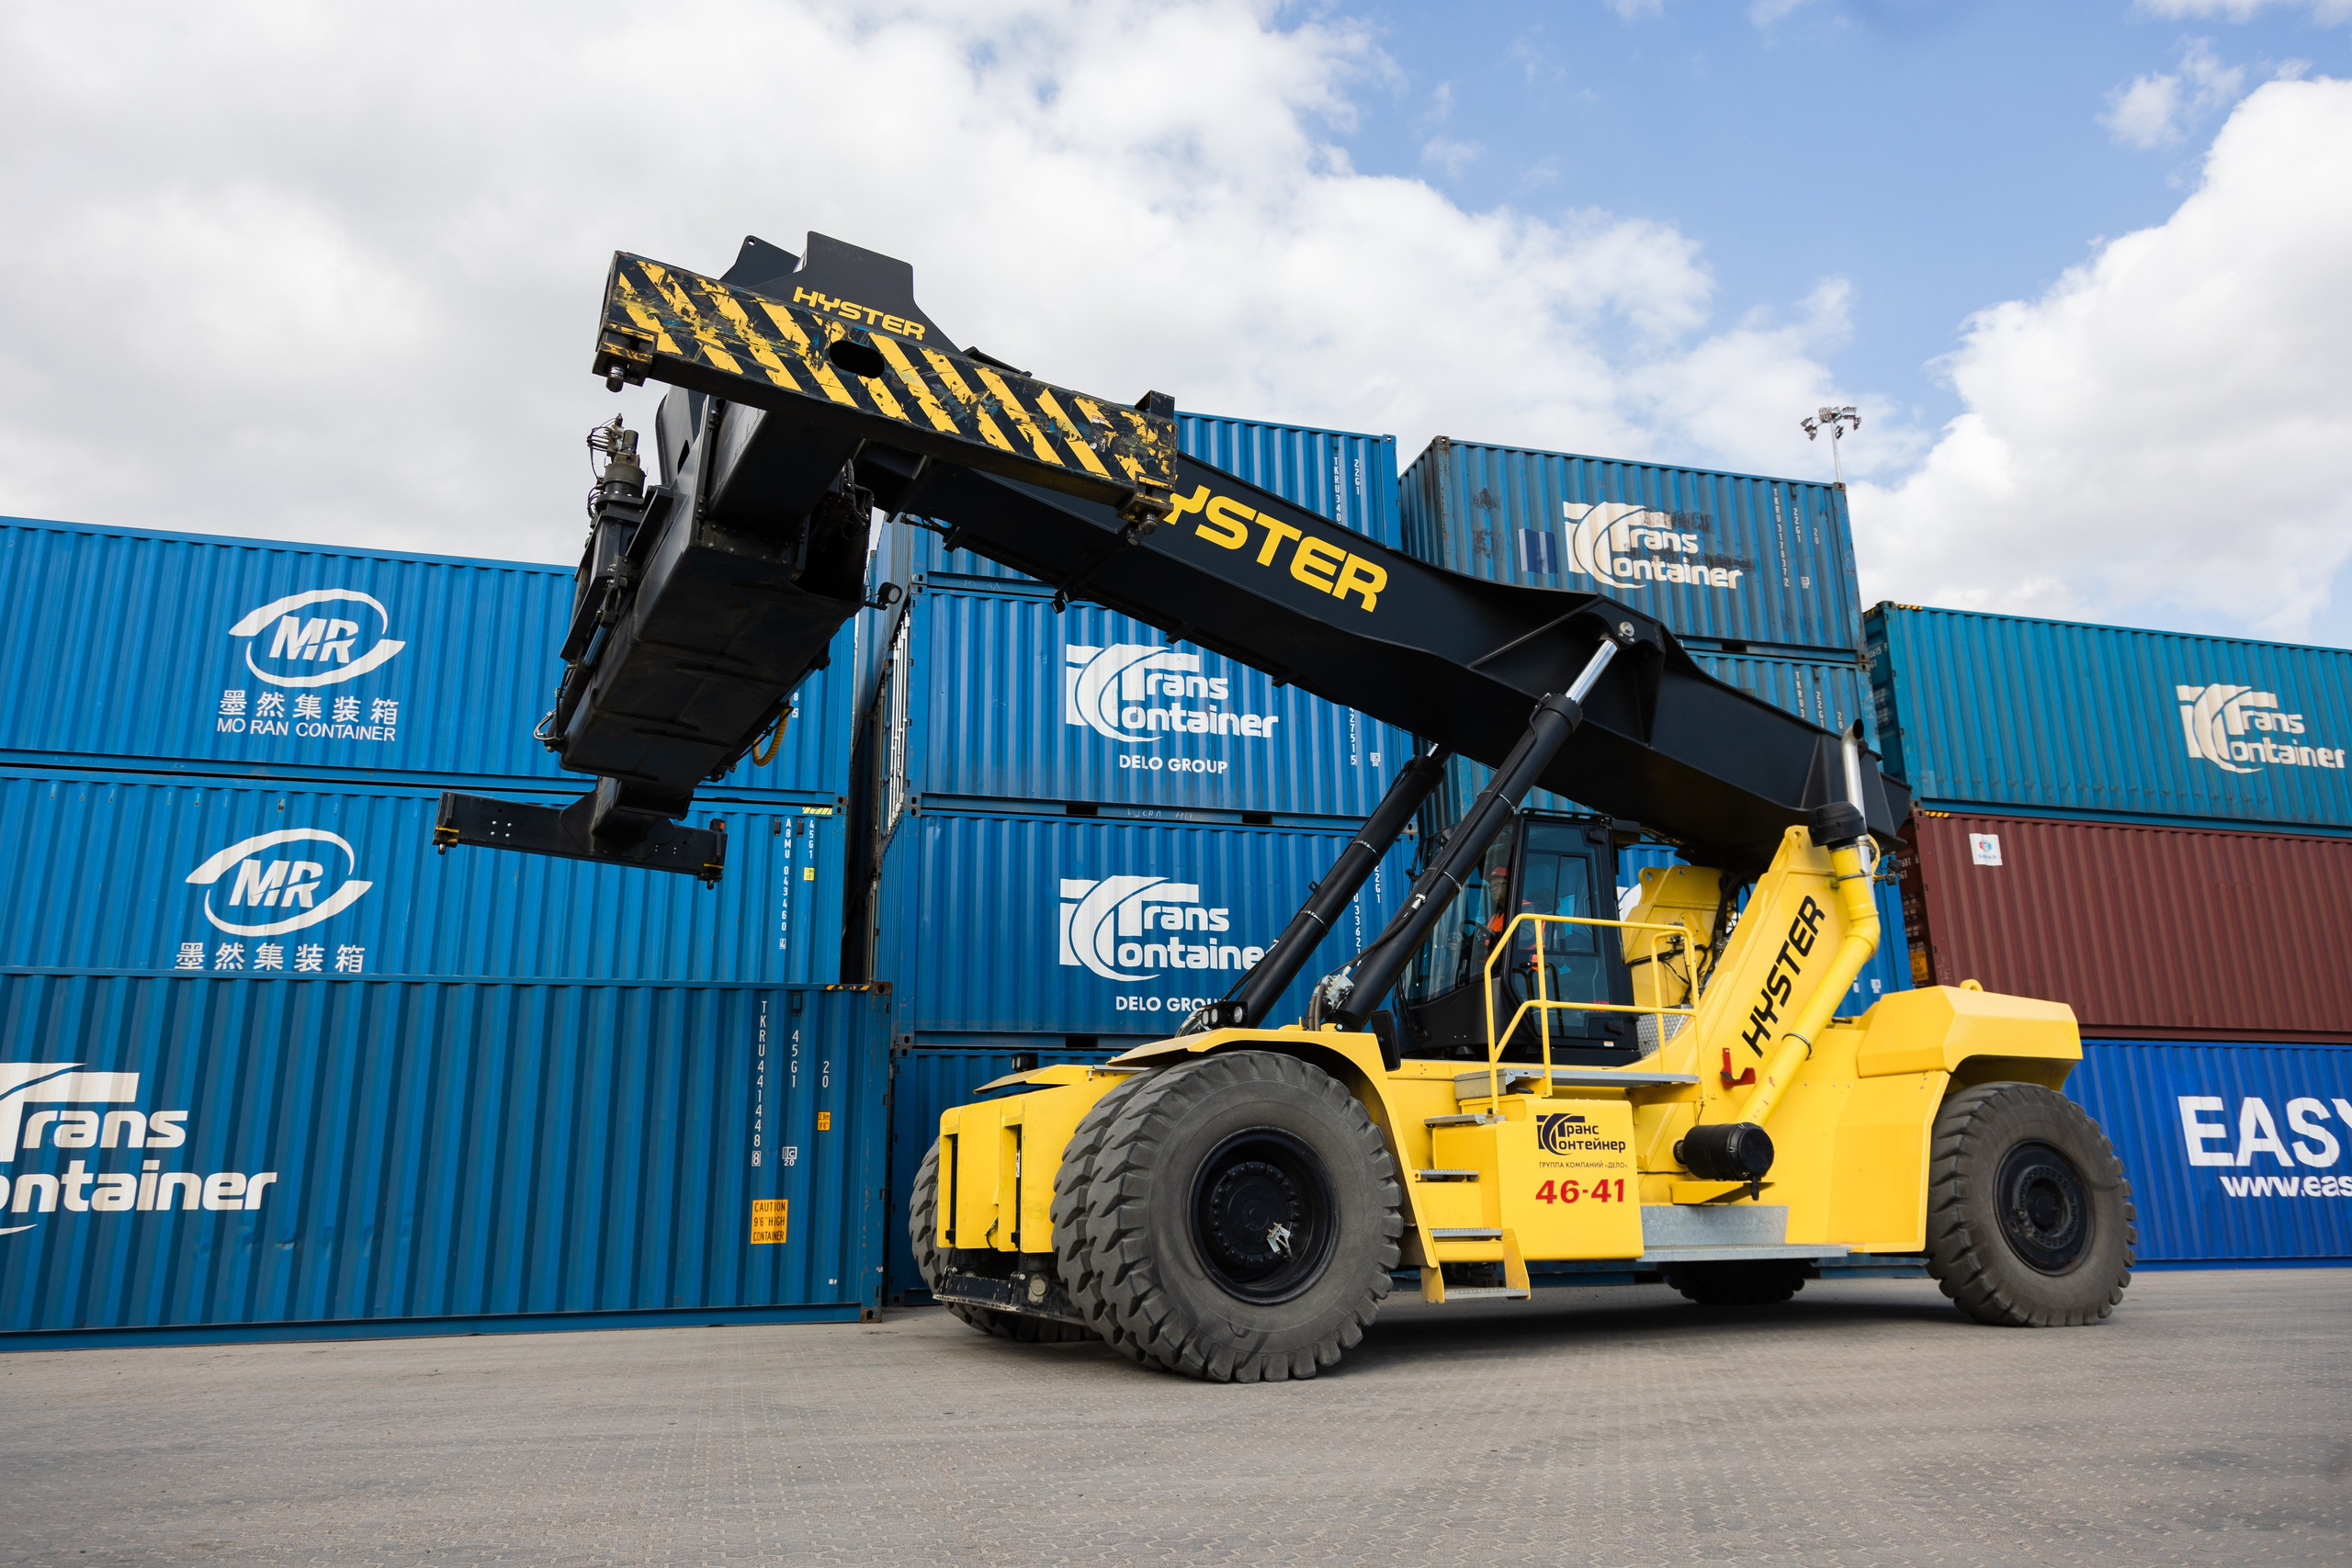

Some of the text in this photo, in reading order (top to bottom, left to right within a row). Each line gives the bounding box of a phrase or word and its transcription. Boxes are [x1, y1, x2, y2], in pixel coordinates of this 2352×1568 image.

[793, 286, 926, 341] HYSTER
[1163, 484, 1388, 613] YSTER
[268, 615, 359, 663] MR
[218, 690, 399, 726] 墨然集装箱
[217, 717, 397, 741] MO RAN CONTAINER
[1119, 754, 1228, 774] DELO GROUP
[229, 859, 323, 908] MR
[175, 942, 366, 973] 墨然集装箱
[1742, 896, 1826, 1058] HYSTER
[1115, 996, 1225, 1011] DELO GRO
[791, 1030, 799, 1088] 45G1
[822, 1061, 830, 1089] 20
[1566, 1160, 1603, 1168] КОМПАНИЙ
[0, 1160, 277, 1213] ntainer
[1535, 1179, 1624, 1204] 46-41
[754, 1201, 786, 1213] CAUTION
[752, 1231, 785, 1242] CONTAINER
